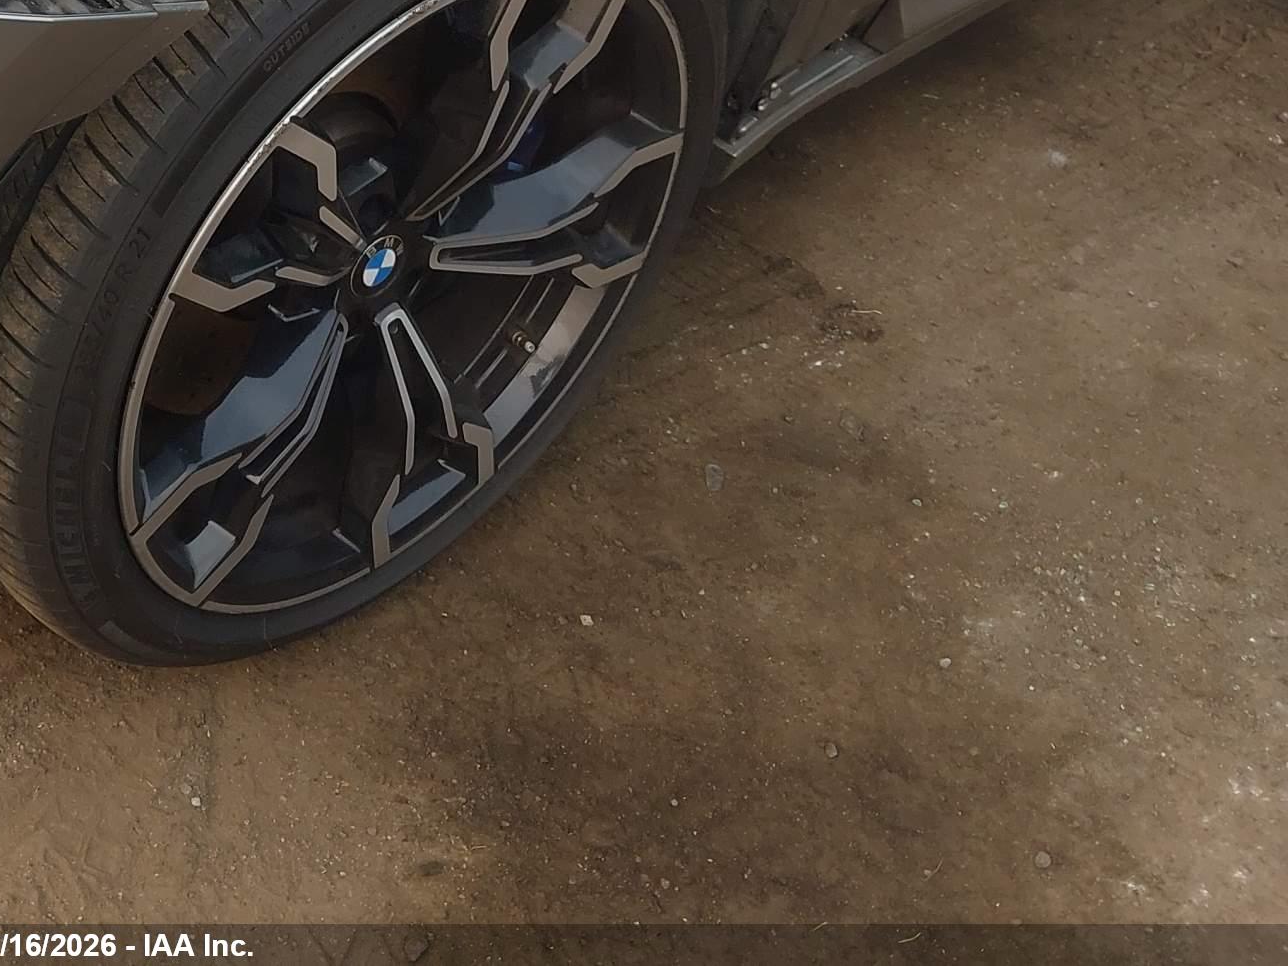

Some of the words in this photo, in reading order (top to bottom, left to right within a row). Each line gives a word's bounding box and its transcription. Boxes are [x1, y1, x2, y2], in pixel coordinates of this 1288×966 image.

[263, 22, 311, 72] OUTSIDE
[128, 226, 152, 259] 21
[365, 237, 404, 259] BMW
